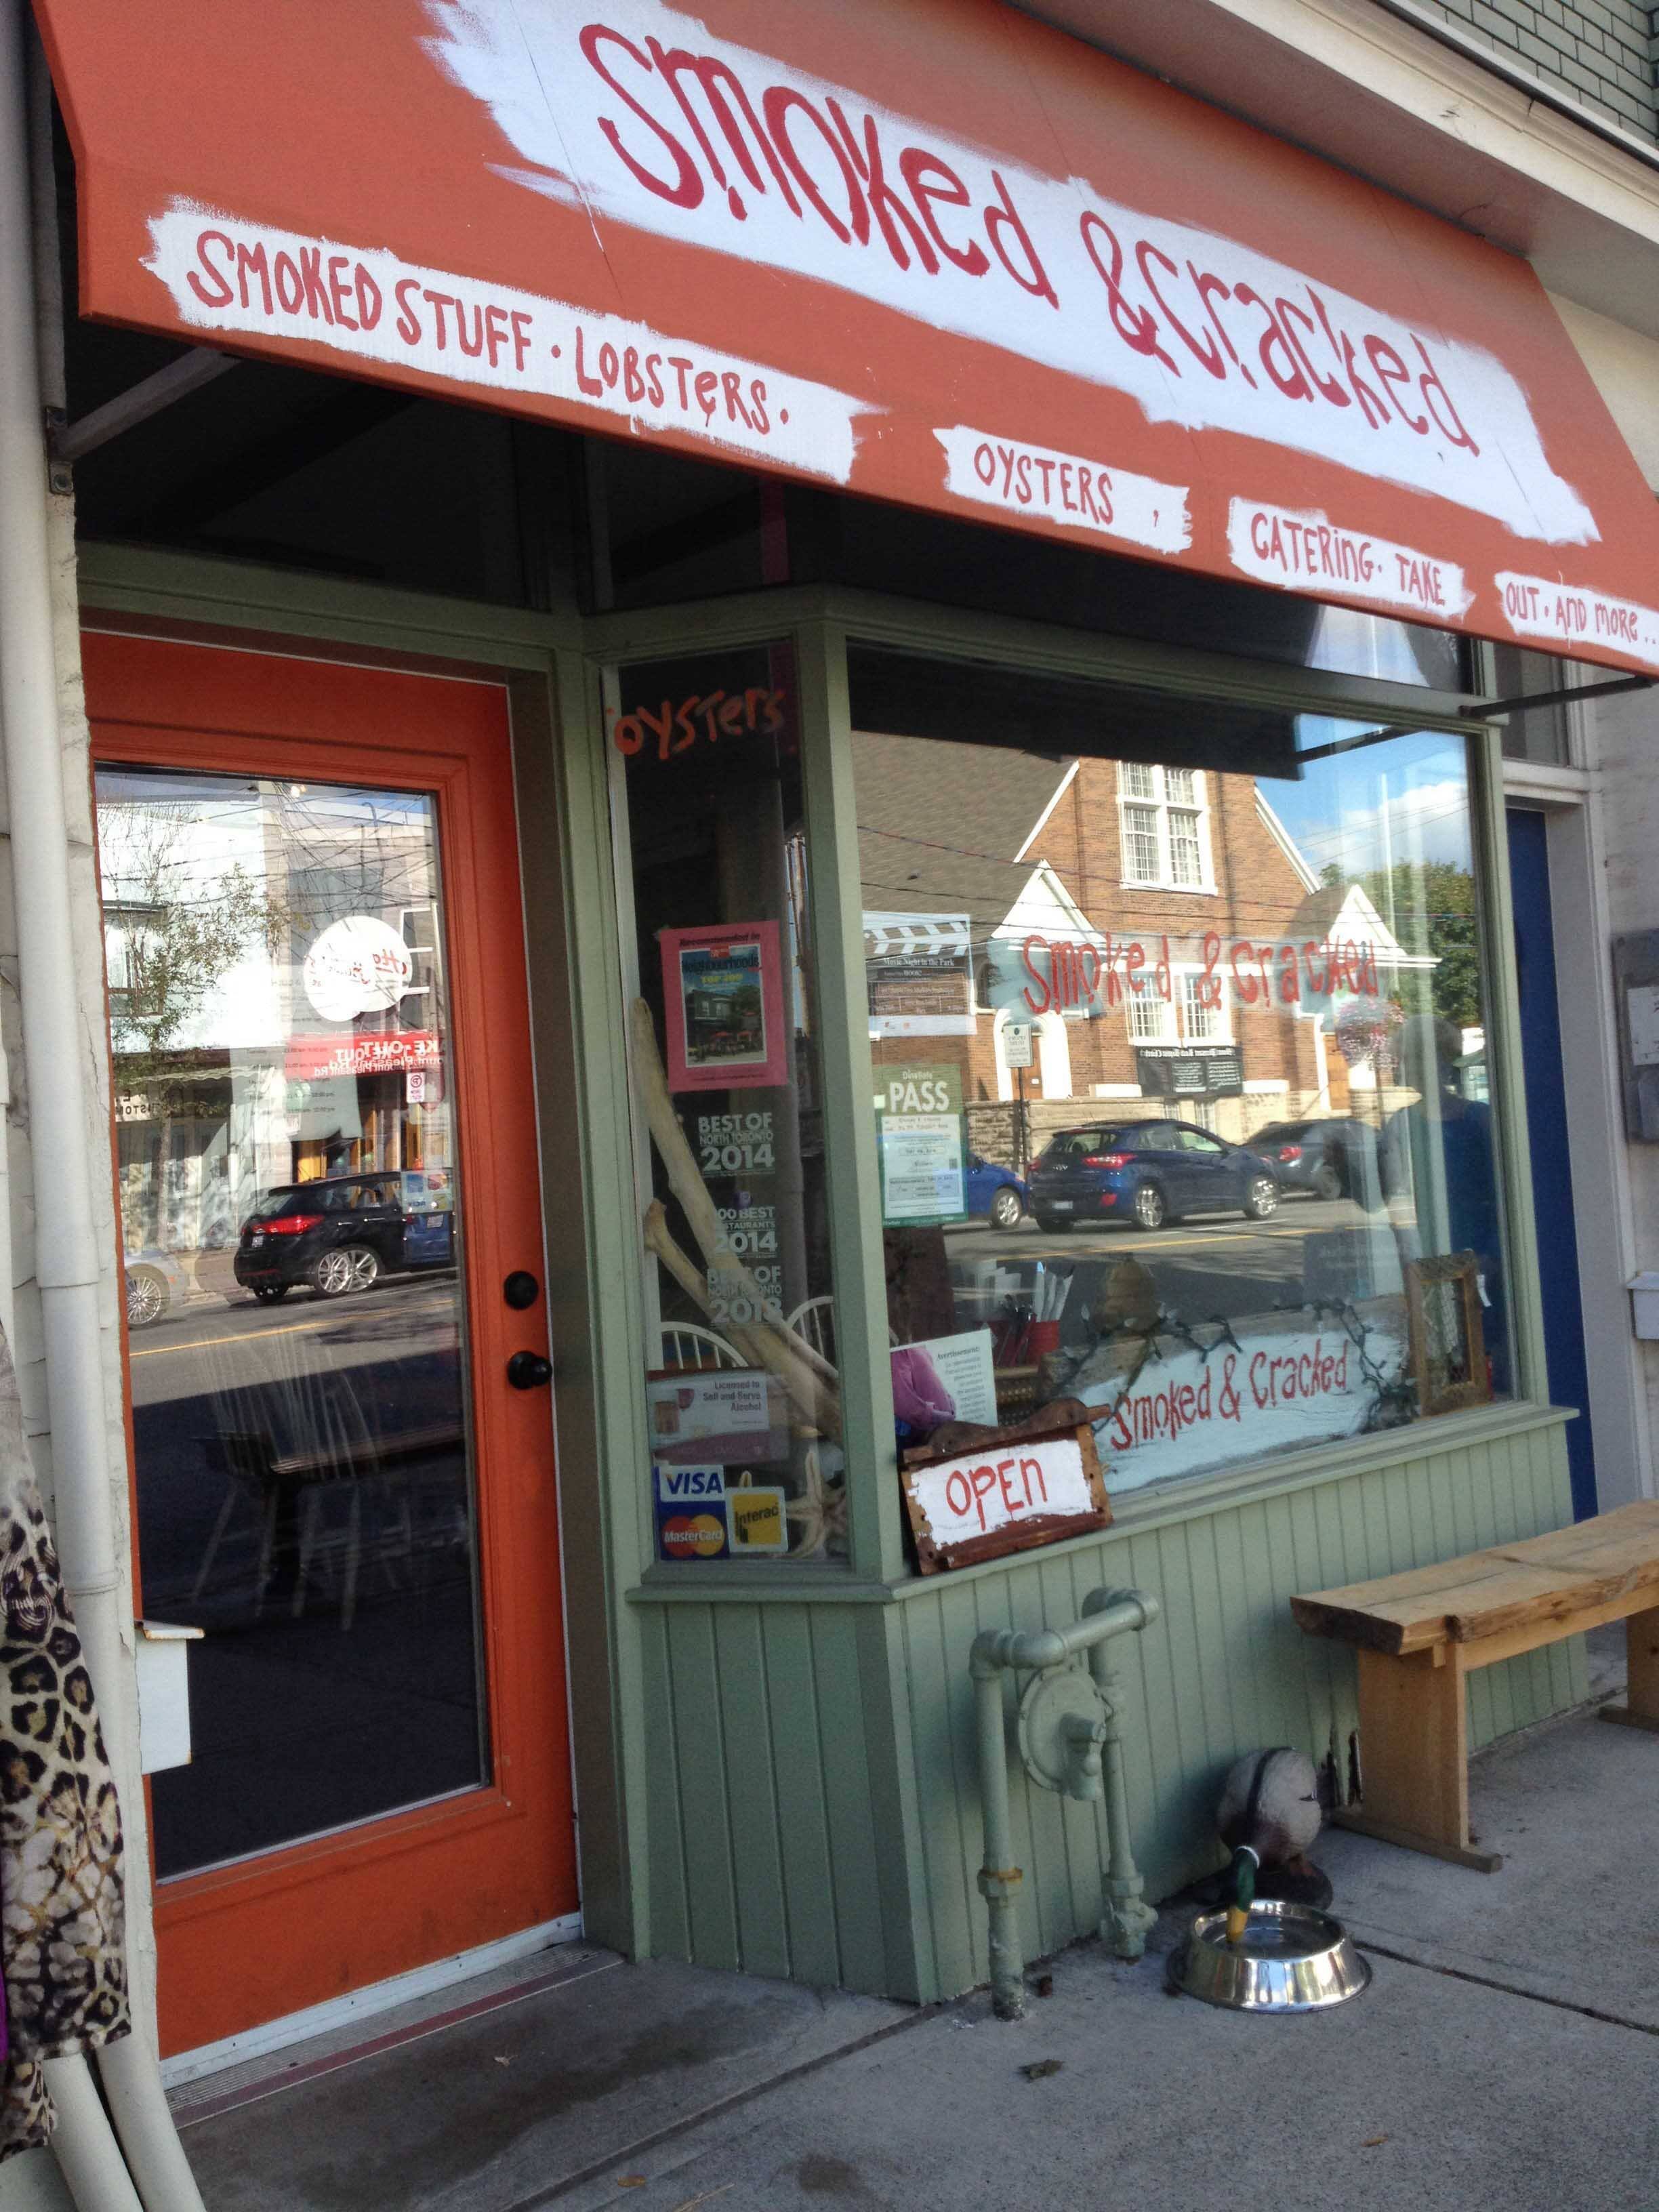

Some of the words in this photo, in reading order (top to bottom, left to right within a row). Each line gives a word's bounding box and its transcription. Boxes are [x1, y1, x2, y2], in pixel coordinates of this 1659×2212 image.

[187, 230, 382, 331] SMOKED
[395, 279, 532, 371] STUFF
[974, 443, 1113, 525] OYSTERS
[1395, 553, 1446, 607] TAKE
[1506, 581, 1540, 621] OUT
[1197, 930, 1222, 1010] &
[888, 1080, 949, 1113] PASS
[697, 1115, 743, 1134] BEST
[746, 1111, 773, 1131] OF
[699, 1133, 732, 1146] NORTH
[700, 1143, 776, 1172] 2014
[739, 1206, 776, 1219] BEST
[716, 1230, 778, 1254] 2014
[753, 1265, 781, 1284] OF
[703, 1391, 719, 1402] Sell
[720, 1392, 736, 1401] and
[737, 1391, 761, 1401] Serve
[714, 1380, 749, 1390] Licensed
[750, 1380, 760, 1389] to
[1218, 1353, 1241, 1422] &
[731, 1402, 762, 1412] Alcohol
[665, 1472, 722, 1494] VISA
[735, 1504, 779, 1526] Interac
[664, 1528, 724, 1543] MasterCard
